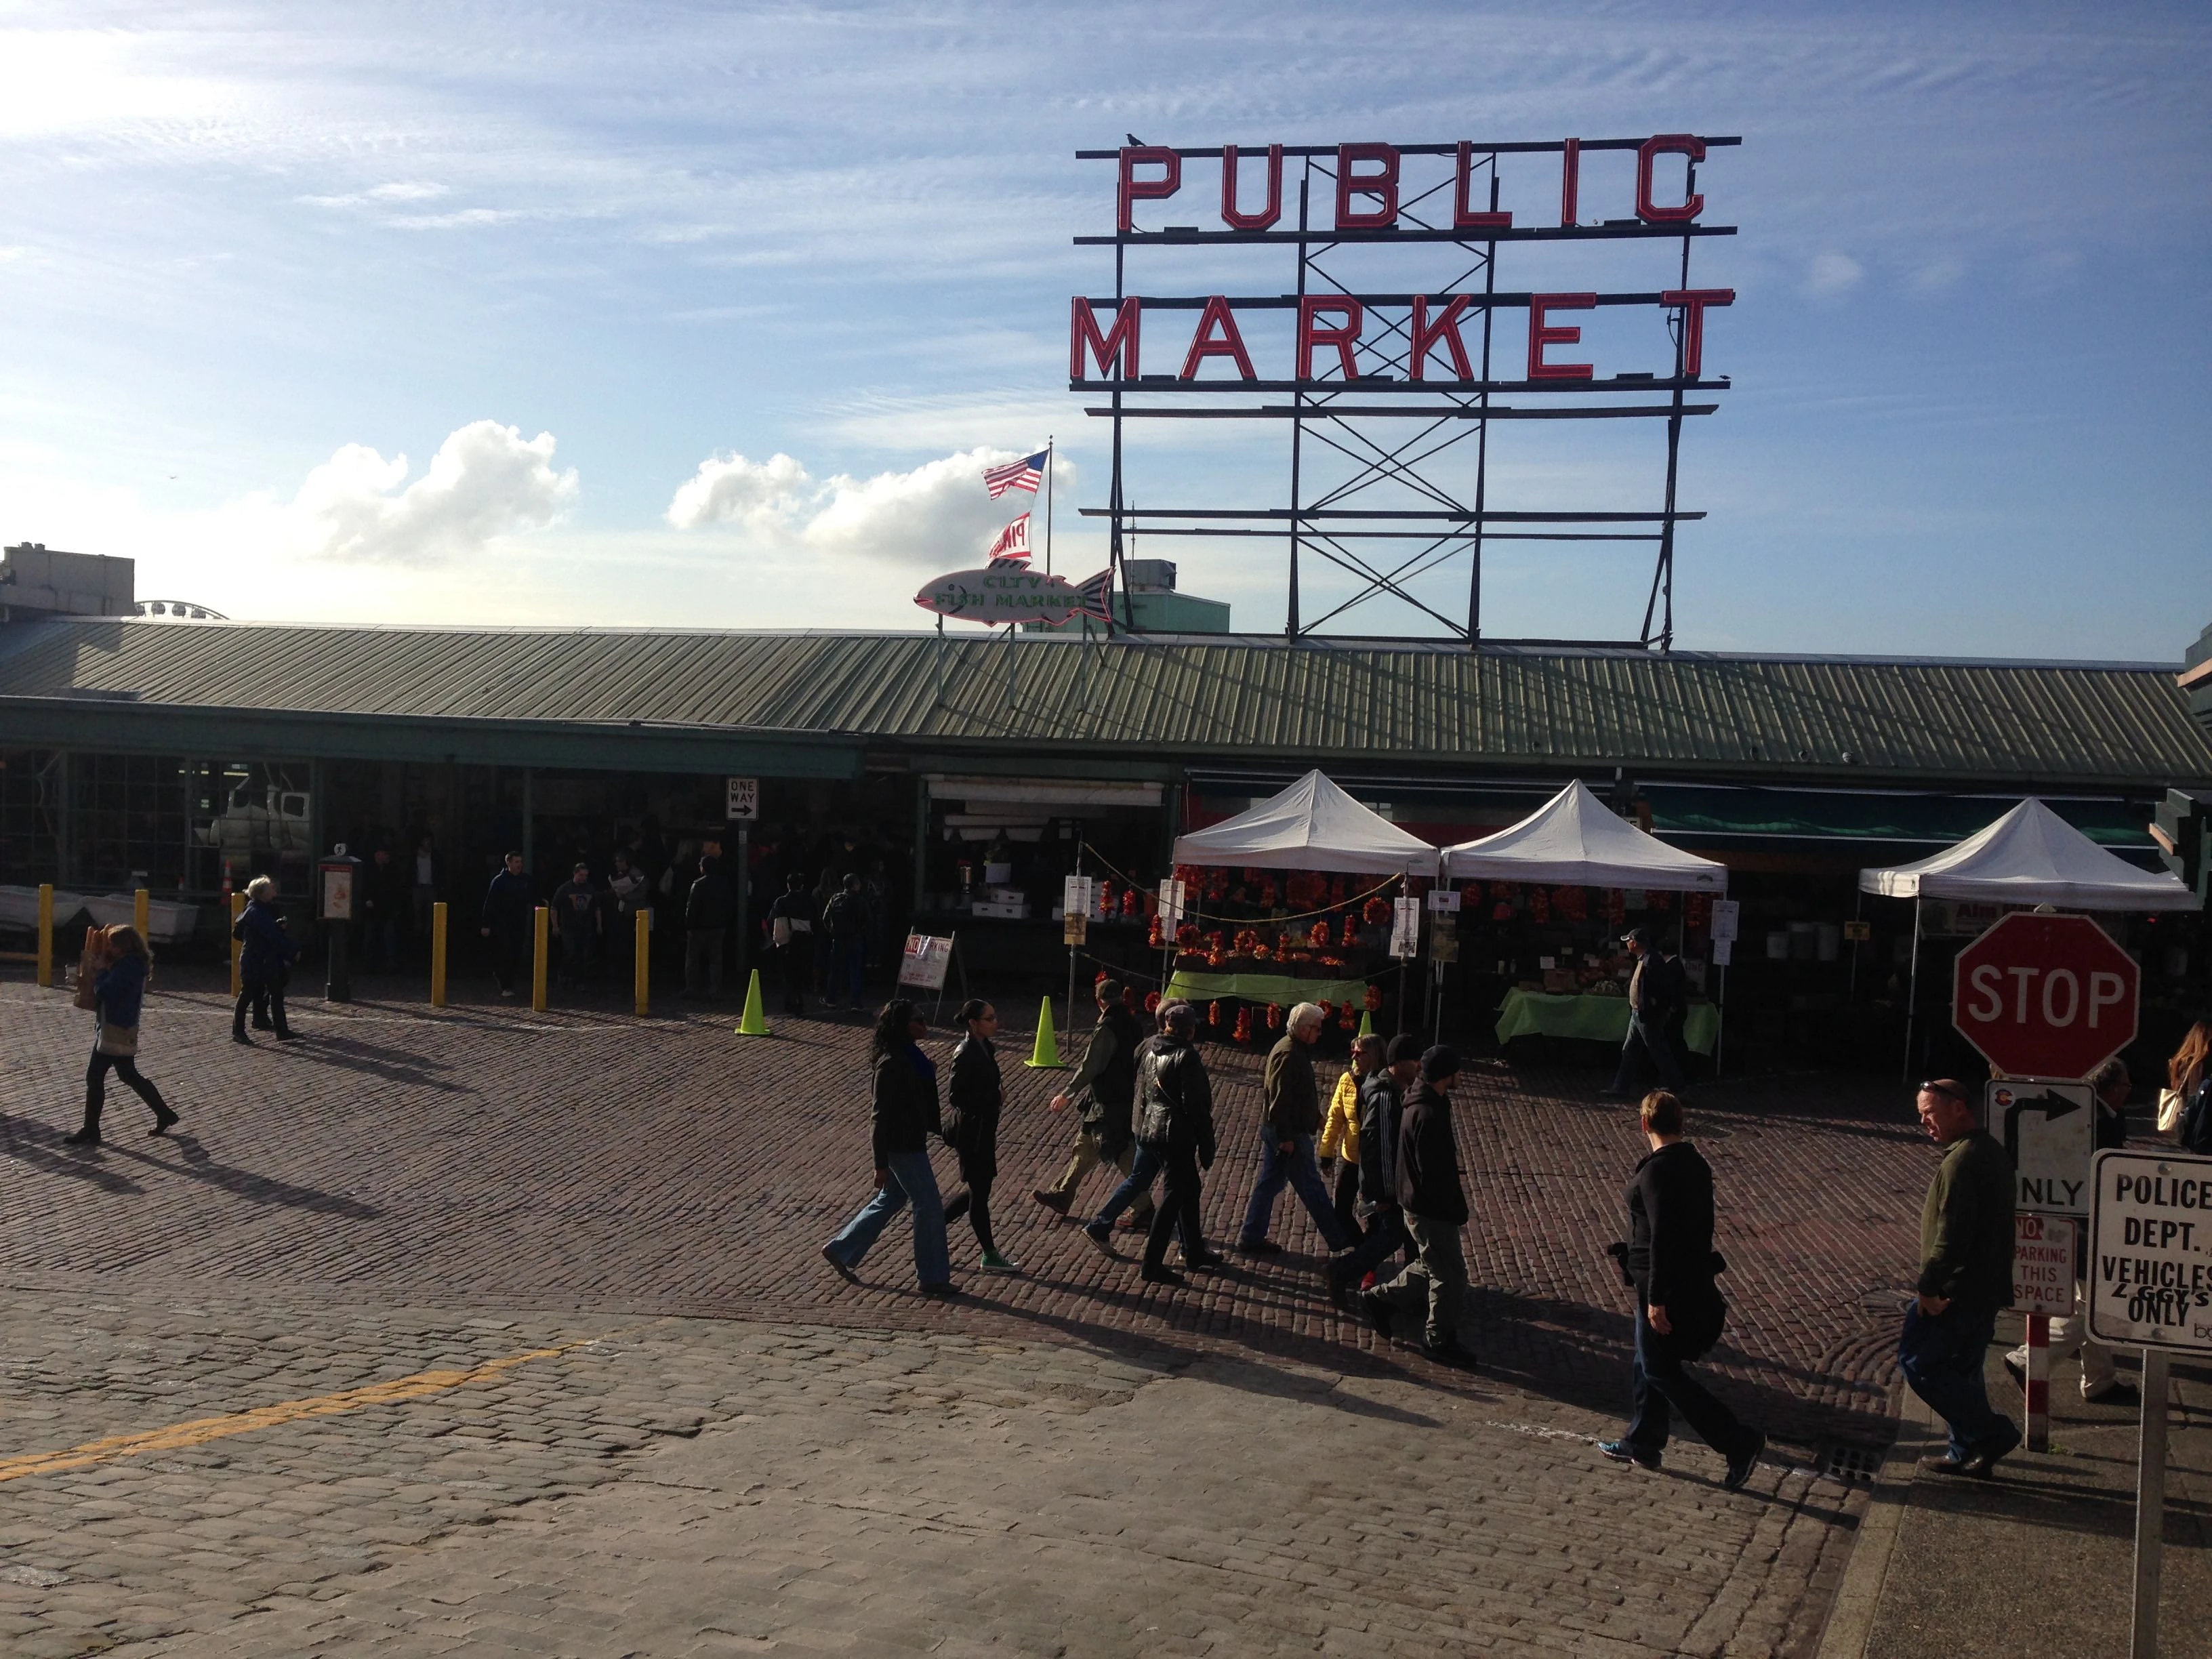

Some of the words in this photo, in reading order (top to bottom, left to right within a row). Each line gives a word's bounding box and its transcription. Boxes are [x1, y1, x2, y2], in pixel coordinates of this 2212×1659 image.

[1118, 134, 1706, 232] PUBLIC
[1071, 289, 1734, 381] MARKET
[983, 576, 1042, 589] CITY
[935, 592, 983, 607] FISH
[995, 594, 1088, 608] MARKET
[731, 781, 754, 792] ONE
[730, 792, 756, 803] WAY
[908, 937, 919, 951] NO
[1968, 964, 2125, 1028] STOP
[2022, 1177, 2083, 1206] NLY
[2116, 1174, 2212, 1210] POLICE
[2125, 1217, 2200, 1251] DEPT.
[2015, 1246, 2066, 1264] PARKING
[2021, 1265, 2057, 1282] THIS
[2014, 1284, 2065, 1303] SPACE
[2129, 1296, 2189, 1327] ONLY
